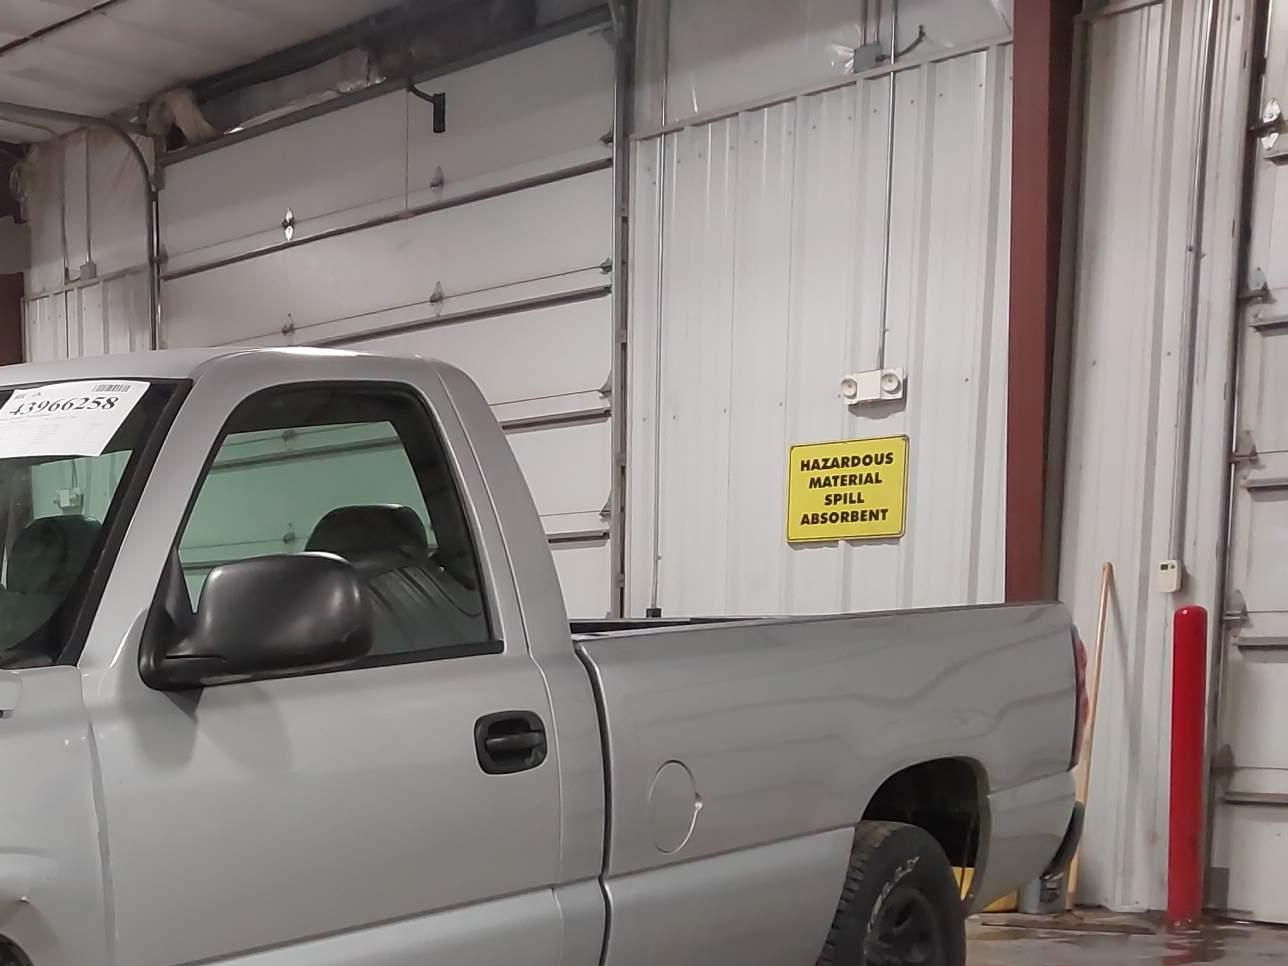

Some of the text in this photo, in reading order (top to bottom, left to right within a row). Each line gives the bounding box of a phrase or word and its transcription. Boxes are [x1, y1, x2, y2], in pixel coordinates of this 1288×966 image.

[10, 396, 118, 415] 43966258
[800, 452, 893, 471] HAZARDOUS
[808, 472, 882, 488] MATERIAL
[824, 492, 864, 505] SPILL
[800, 509, 888, 525] ABSORBENT
